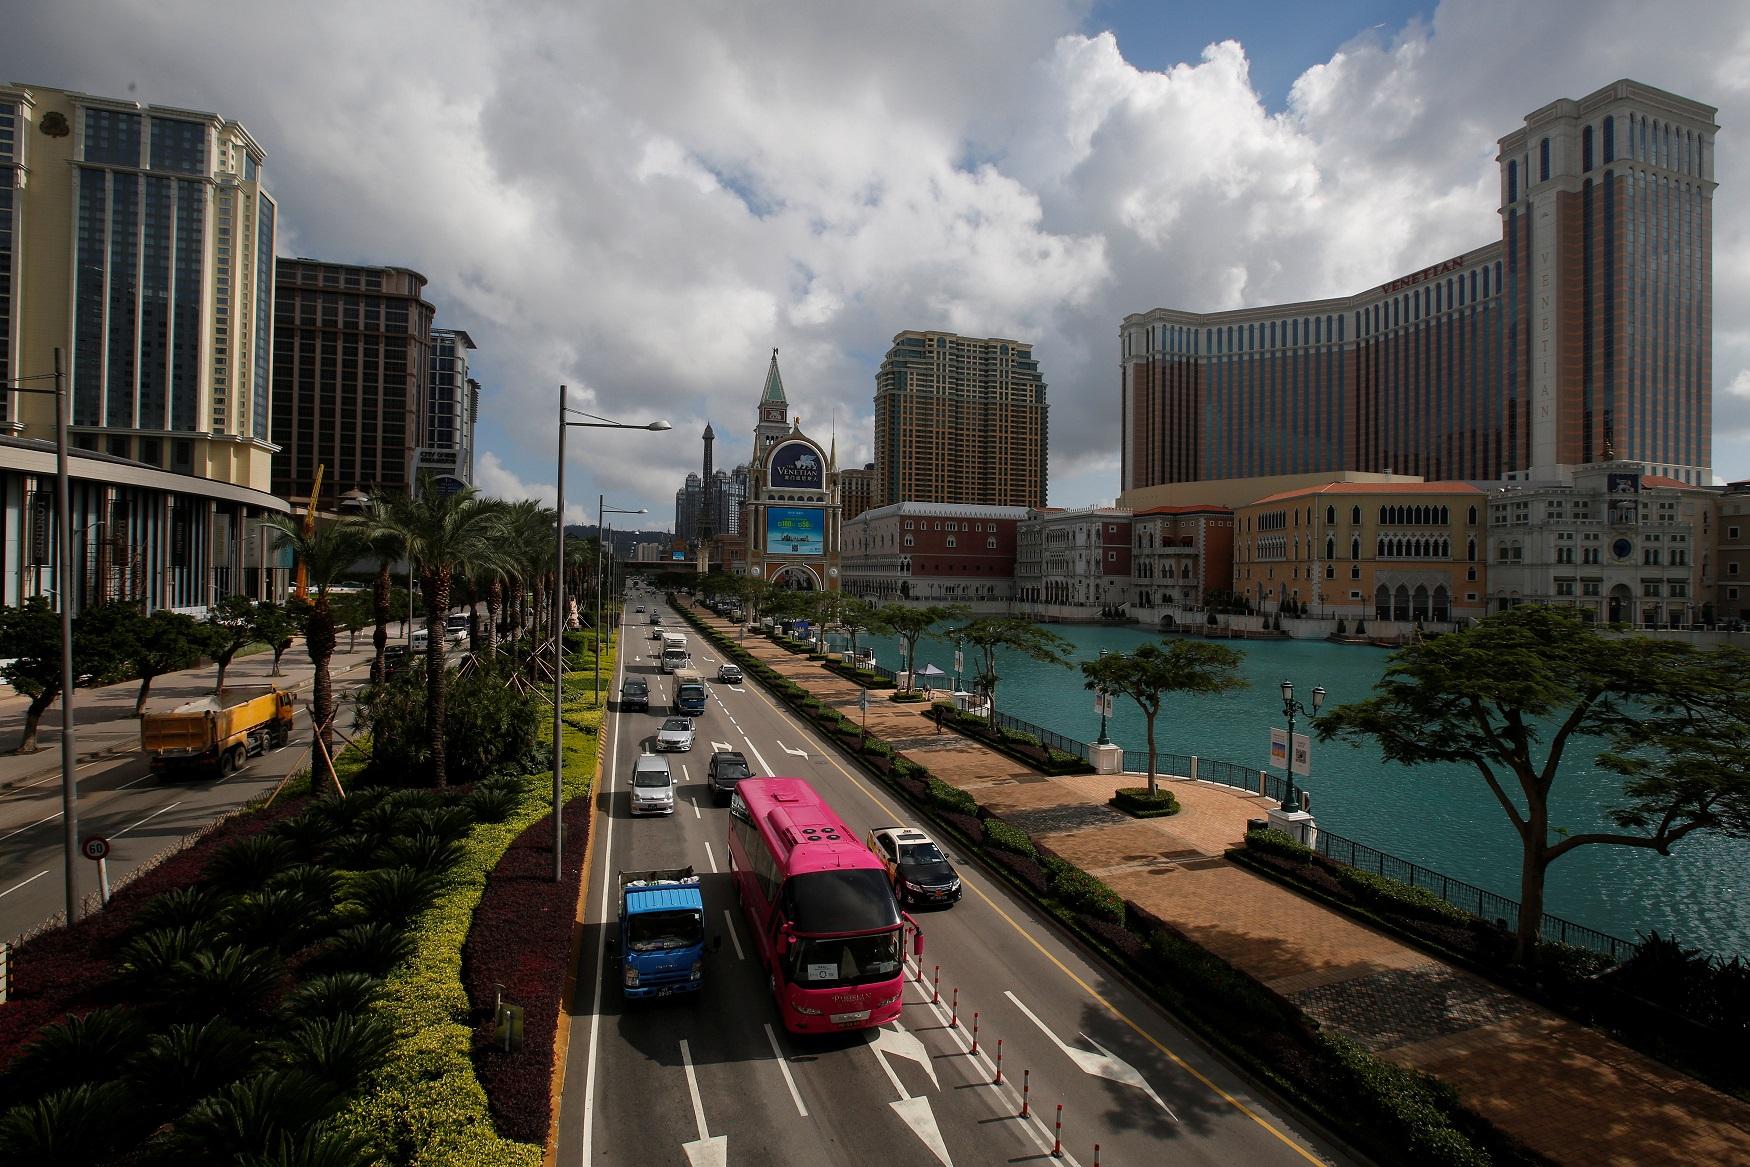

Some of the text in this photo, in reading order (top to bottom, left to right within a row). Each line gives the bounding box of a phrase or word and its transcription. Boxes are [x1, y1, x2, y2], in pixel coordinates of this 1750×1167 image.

[1382, 257, 1464, 294] VENETIAN
[1540, 253, 1549, 417] VENETIAN
[777, 467, 817, 475] VENETIAN
[35, 501, 46, 558] LONGINES
[90, 843, 103, 854] 60
